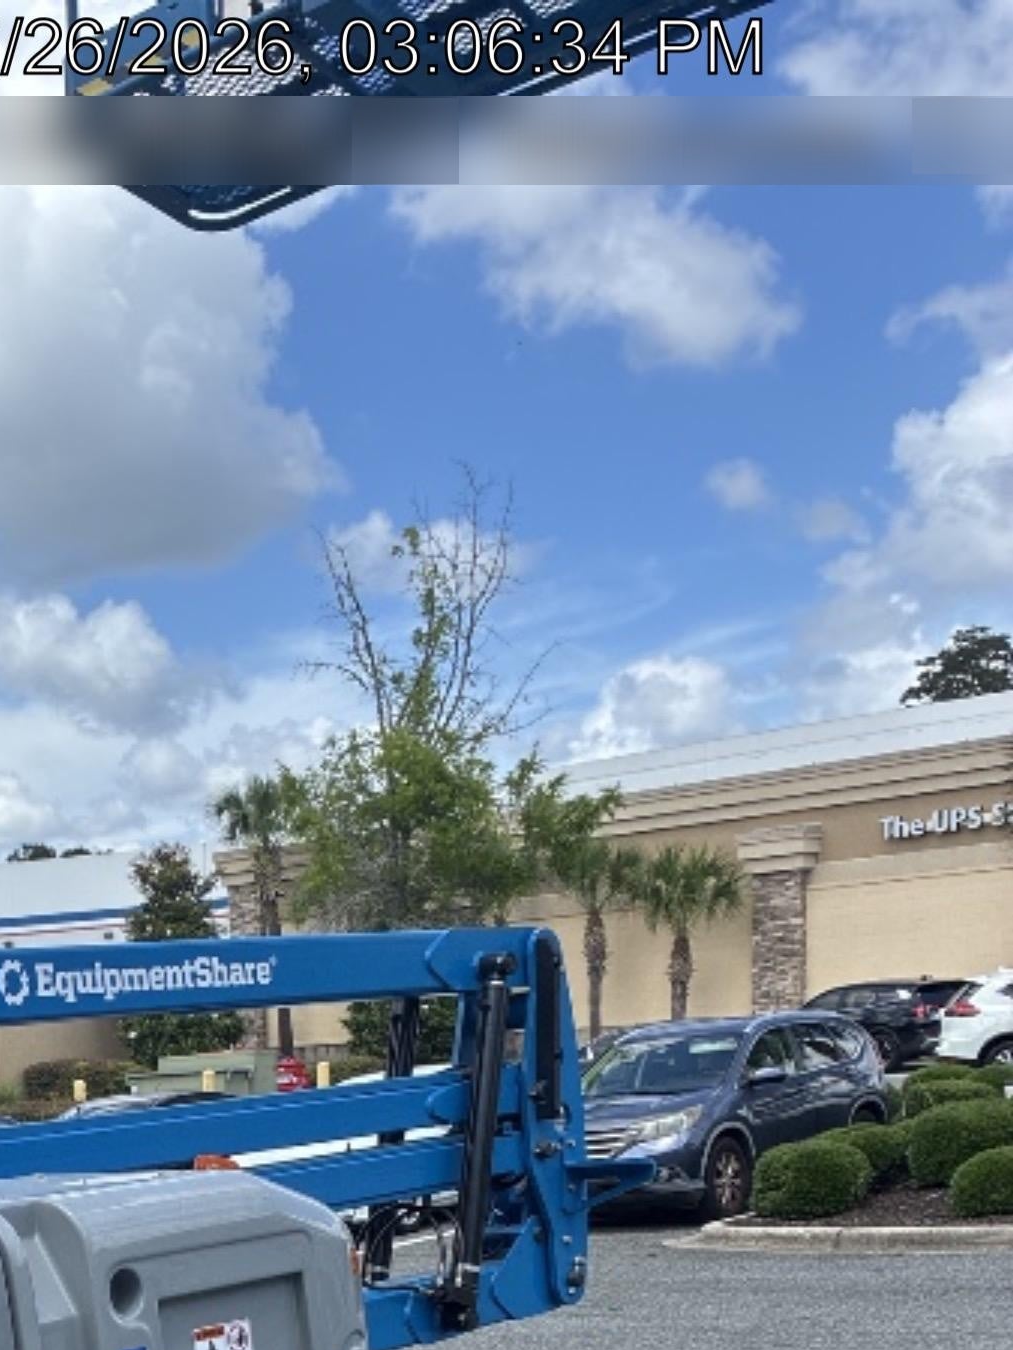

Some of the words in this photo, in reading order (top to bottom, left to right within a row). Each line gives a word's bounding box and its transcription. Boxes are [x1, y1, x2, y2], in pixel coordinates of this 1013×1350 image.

[880, 815, 925, 840] The
[932, 806, 982, 833] UPS
[35, 955, 272, 1003] EquipmentShare
